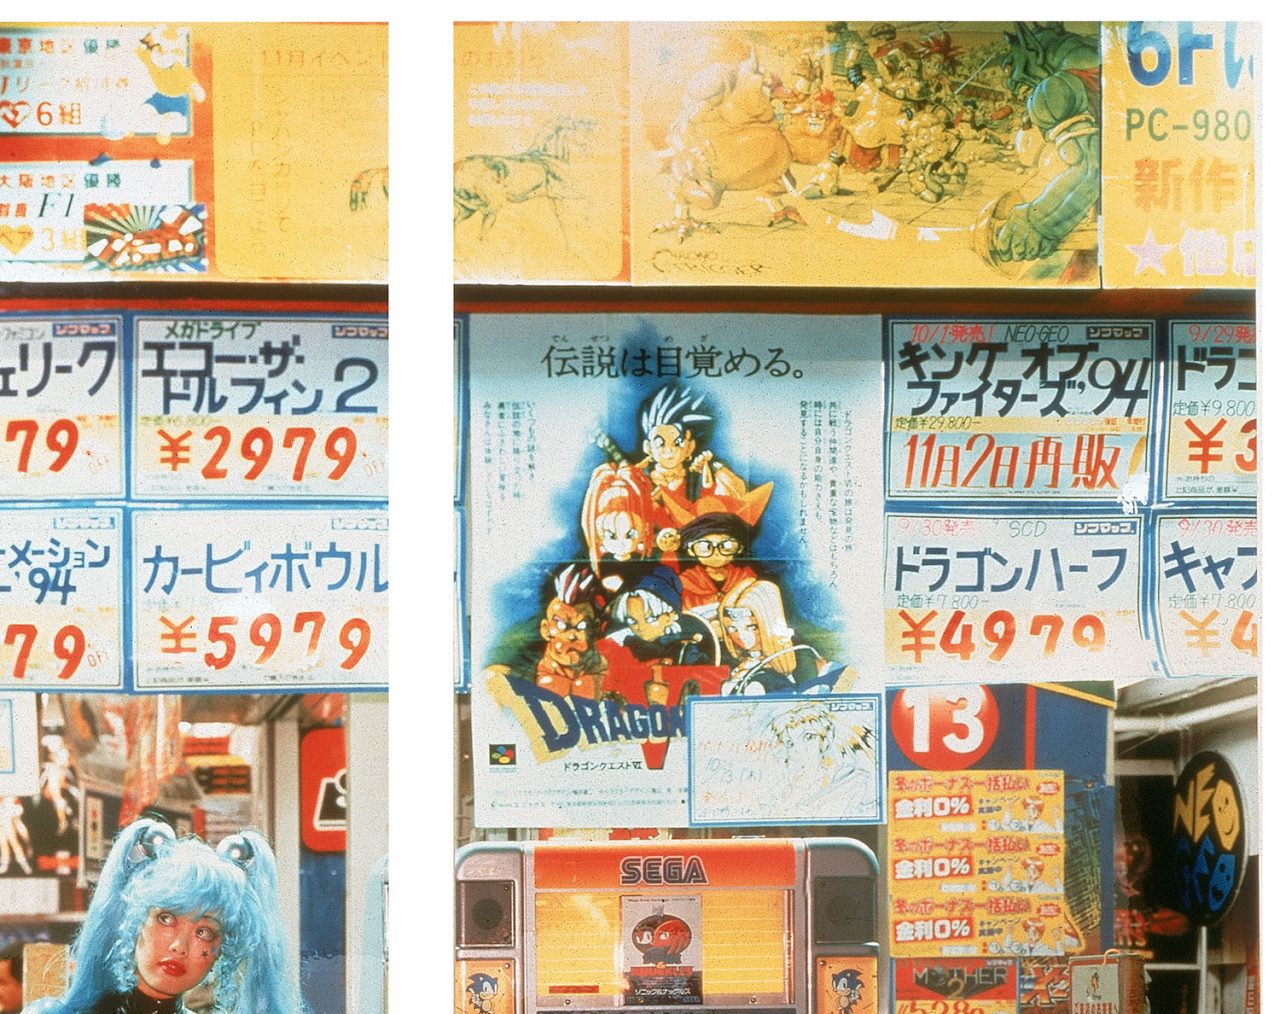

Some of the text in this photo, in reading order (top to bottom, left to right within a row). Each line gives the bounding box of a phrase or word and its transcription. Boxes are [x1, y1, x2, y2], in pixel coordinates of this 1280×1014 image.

[163, 357, 379, 415] ドルフィン 2
[540, 345, 805, 380] 伝説は目覚める。
[898, 342, 1008, 381] キング
[156, 425, 358, 482] ¥2979
[904, 433, 1122, 490] 11月2日再販
[1010, 521, 1047, 538] SCD
[143, 540, 389, 595] カービィボウル
[895, 546, 1128, 592] ドラゴンハーフ
[160, 611, 371, 670] ¥5979
[901, 682, 985, 753] 13
[620, 855, 708, 885] SEGA
